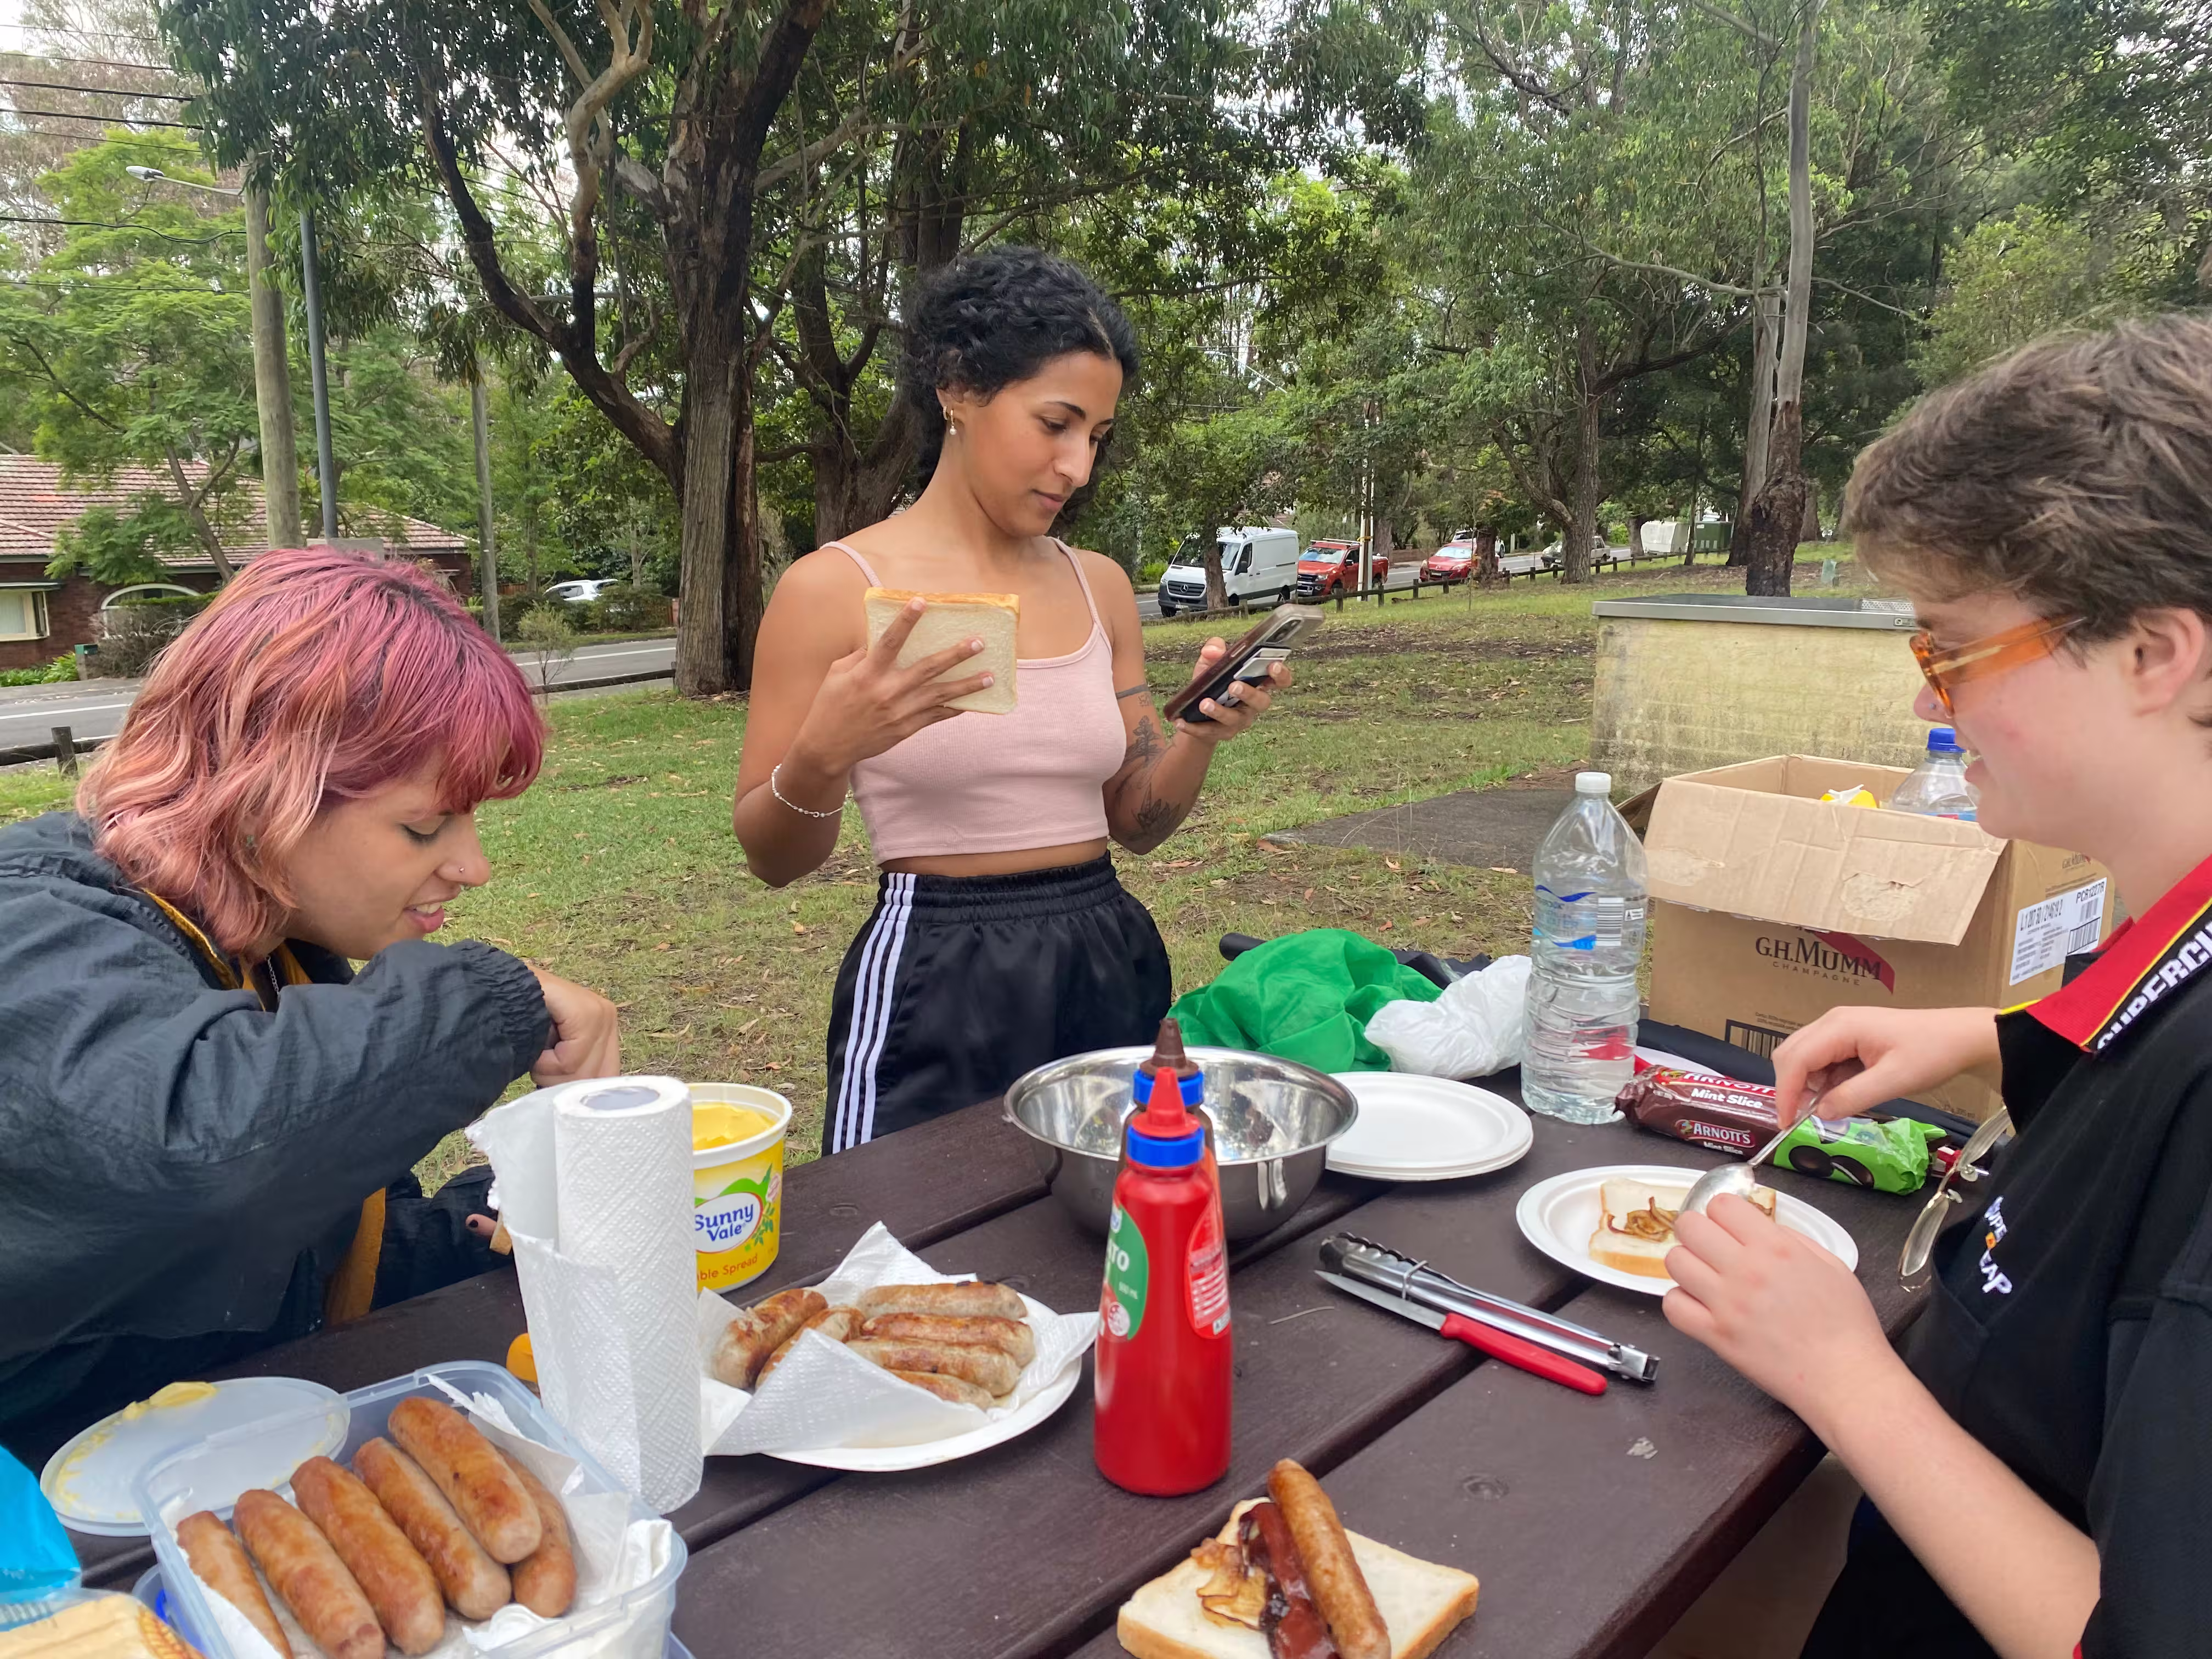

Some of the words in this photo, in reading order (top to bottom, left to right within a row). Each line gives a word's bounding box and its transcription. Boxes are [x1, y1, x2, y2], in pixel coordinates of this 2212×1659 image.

[1773, 961, 1860, 986] CHAMPAGNE
[1684, 1072, 1776, 1096] ARNOTT
[1691, 1088, 1725, 1103] Mint
[1726, 1094, 1763, 1109] Slice
[695, 1204, 754, 1231] Sunny
[707, 1223, 742, 1242] Vale
[722, 1253, 758, 1275] Spread
